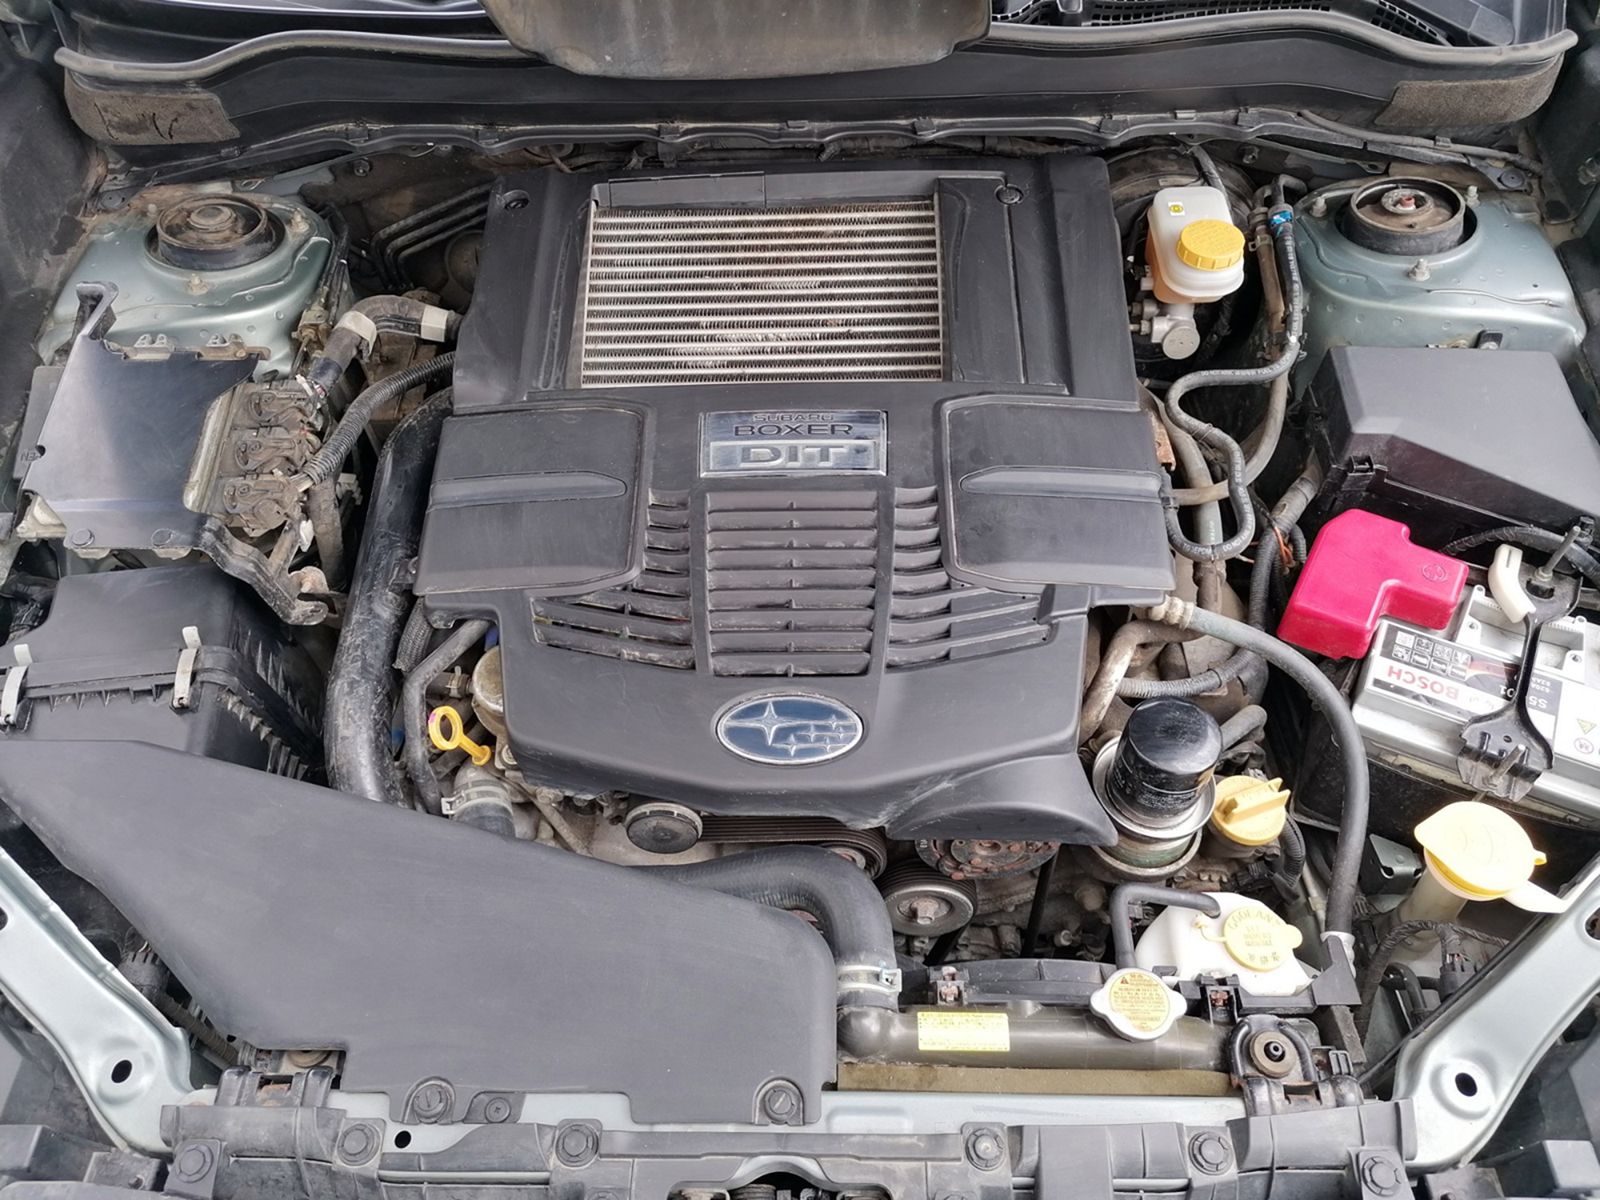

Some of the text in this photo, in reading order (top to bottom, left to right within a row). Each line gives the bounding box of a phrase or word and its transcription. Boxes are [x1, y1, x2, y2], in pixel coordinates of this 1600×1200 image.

[753, 413, 834, 422] SUBARU
[734, 423, 853, 437] BOXER
[739, 445, 849, 468] DIT
[1387, 665, 1460, 701] BOSCH
